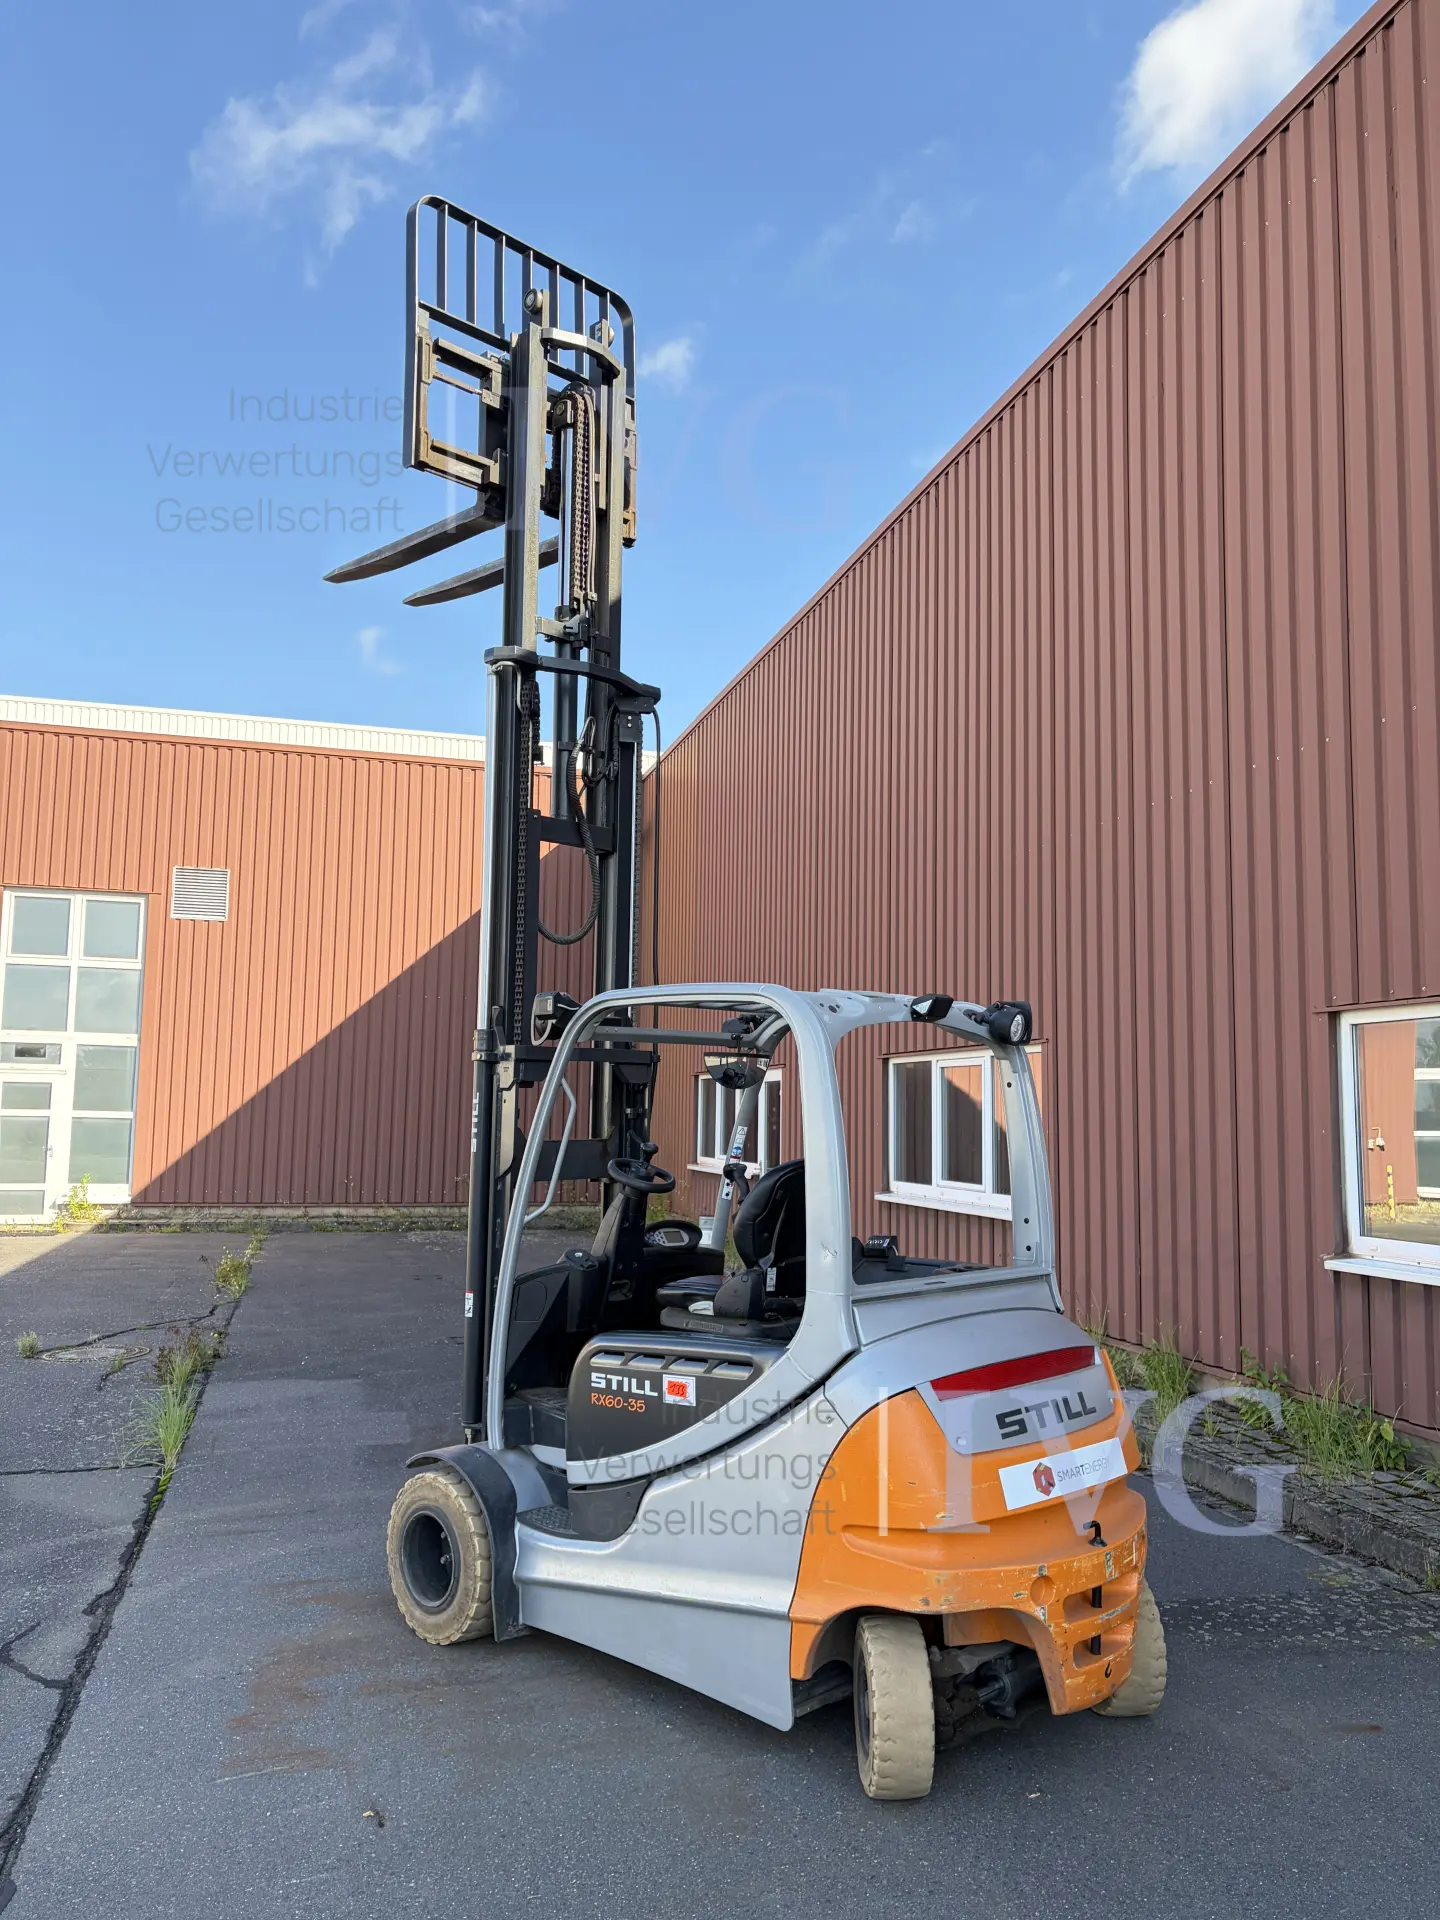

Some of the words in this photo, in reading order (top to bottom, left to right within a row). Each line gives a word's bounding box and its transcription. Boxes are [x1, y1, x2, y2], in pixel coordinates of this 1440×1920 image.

[591, 1372, 658, 1397] STILL
[591, 1393, 646, 1413] RX60-35
[996, 1391, 1098, 1440] STILL
